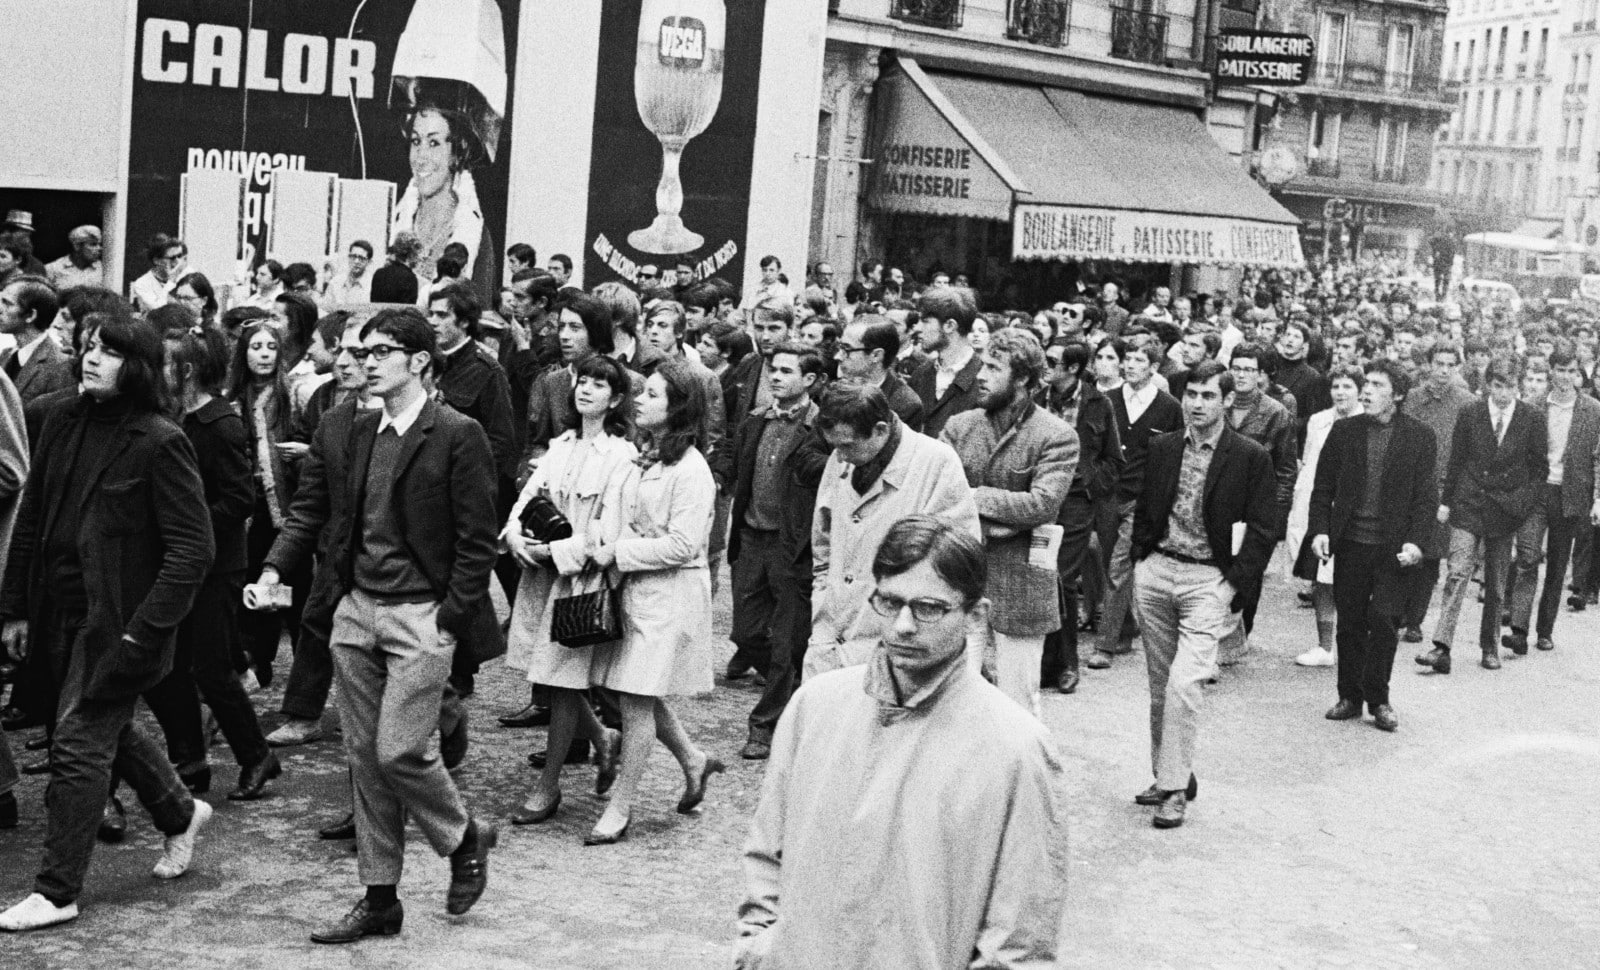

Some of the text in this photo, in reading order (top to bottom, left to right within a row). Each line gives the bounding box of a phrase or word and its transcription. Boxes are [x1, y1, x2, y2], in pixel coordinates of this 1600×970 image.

[141, 17, 376, 99] CALOR
[1218, 35, 1312, 57] BOULANGERIE
[1218, 58, 1302, 81] PATISSERIE
[883, 144, 971, 170] CONFISERIE
[1022, 211, 1297, 264] BOULANGERIE PATISSERIE CONFISERIE
